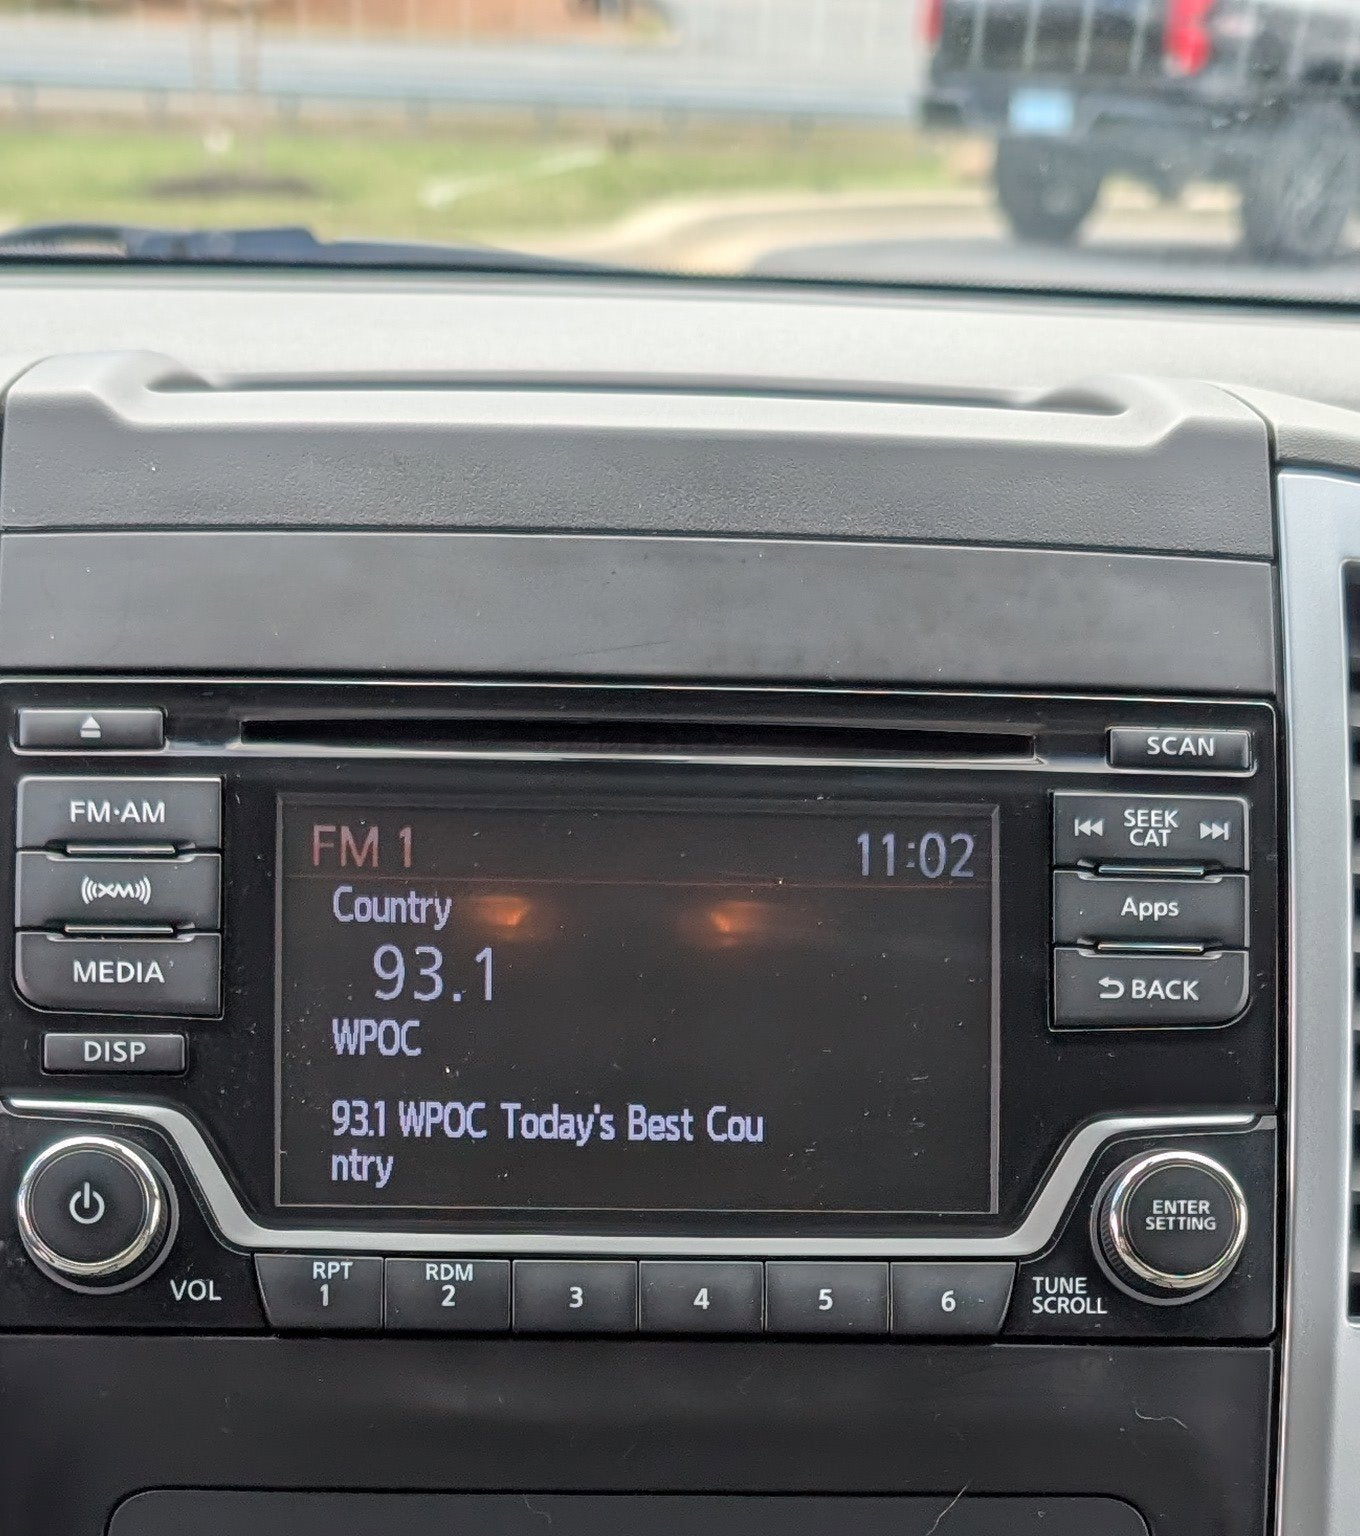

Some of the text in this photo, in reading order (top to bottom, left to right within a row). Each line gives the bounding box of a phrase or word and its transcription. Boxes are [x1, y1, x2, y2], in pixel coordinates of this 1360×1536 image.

[1146, 736, 1215, 757] SCAN
[1123, 809, 1179, 828] SEEK
[311, 824, 413, 868] FM 1
[1129, 829, 1171, 847] CAT
[856, 831, 975, 879] 11:02
[332, 885, 453, 931] Country
[1120, 897, 1180, 918] Apps
[73, 960, 165, 983] MEDIA
[372, 944, 493, 1002] 93.1
[1131, 979, 1200, 1001] BACK
[332, 1018, 422, 1057] WPOC
[83, 1041, 147, 1063] DISP
[331, 1099, 764, 1147] 93.1 WPOC Today's Best Cou
[330, 1148, 394, 1189] ntry
[1152, 1199, 1211, 1215] ENTER
[1144, 1216, 1217, 1231] SETTING
[312, 1261, 353, 1280] RPT
[425, 1262, 474, 1282] RDM
[170, 1278, 222, 1302] VOL
[319, 1283, 330, 1307] 1
[440, 1284, 456, 1308] 2
[1031, 1276, 1088, 1295] TUNE
[568, 1286, 584, 1309] 3
[692, 1287, 711, 1310] 4
[817, 1288, 834, 1311] 5
[940, 1290, 957, 1313] 6
[1031, 1297, 1108, 1315] SCROLL
